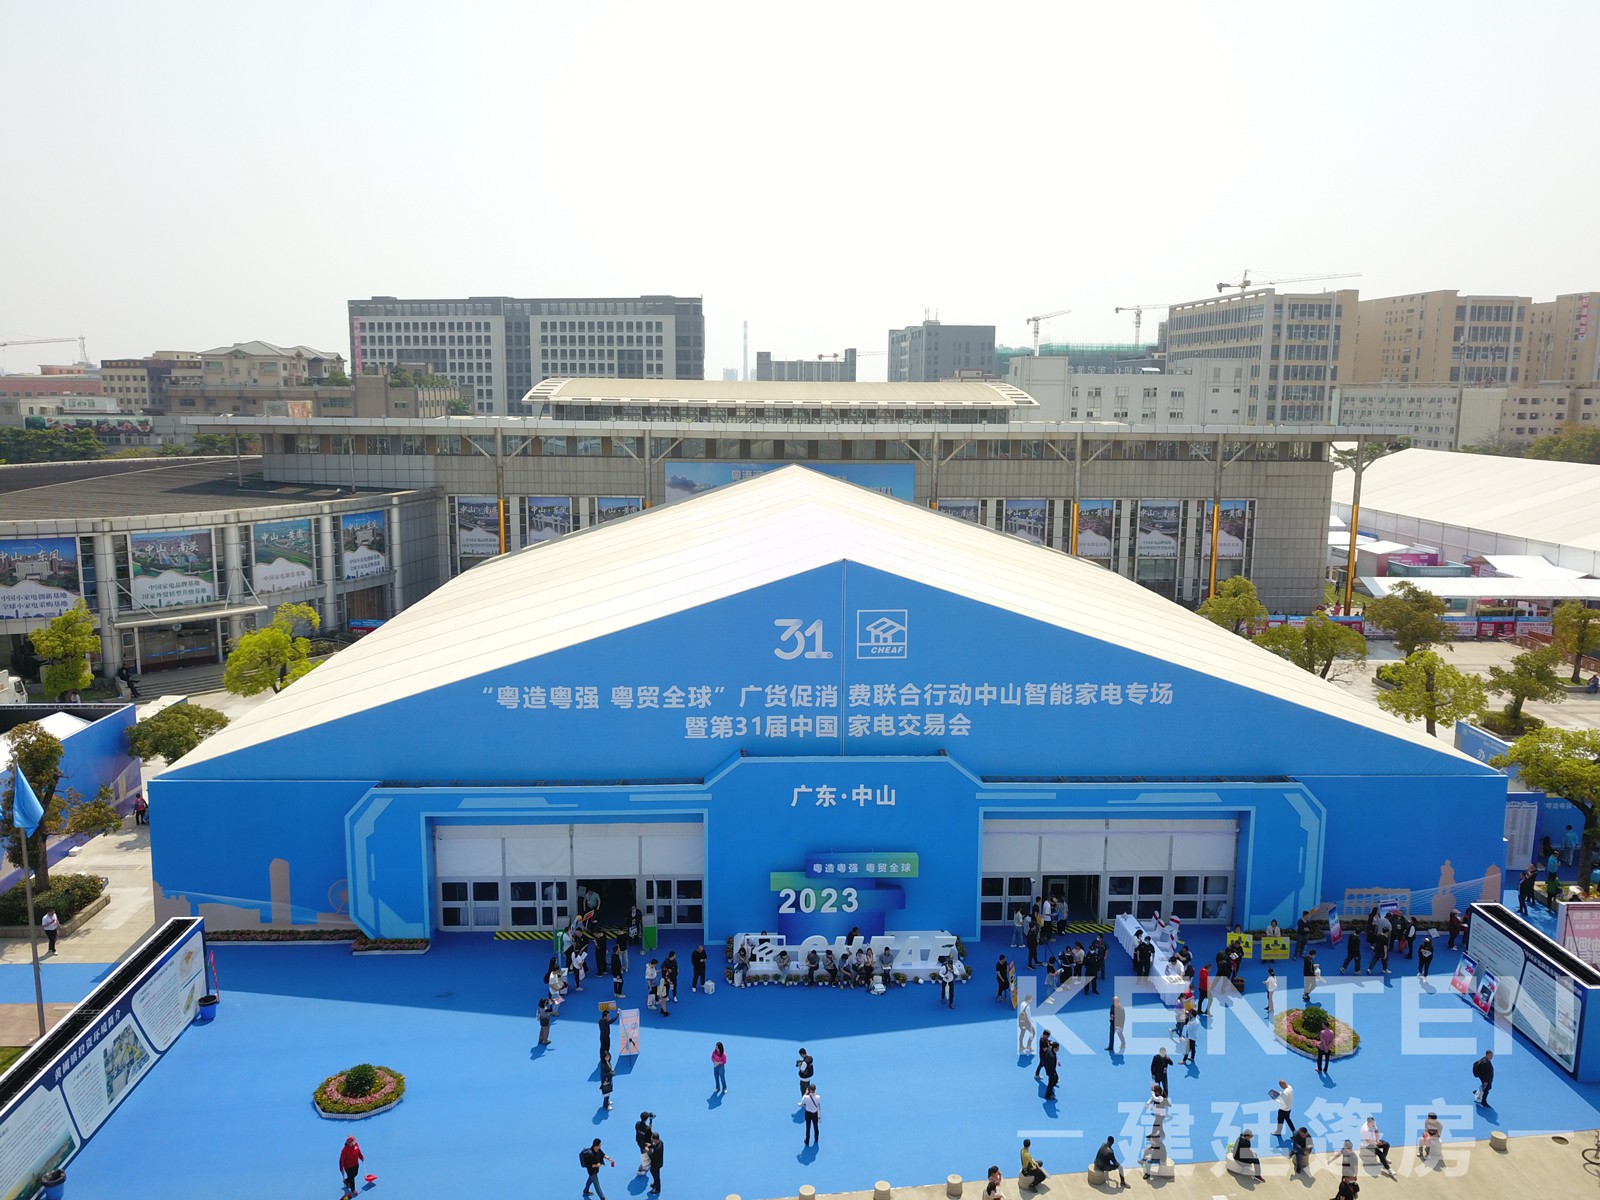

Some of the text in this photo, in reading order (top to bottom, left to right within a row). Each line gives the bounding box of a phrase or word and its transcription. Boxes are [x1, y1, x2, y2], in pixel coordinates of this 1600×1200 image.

[773, 618, 834, 660] 31
[870, 646, 904, 654] CHEAF
[790, 785, 897, 808] 广东·中山
[812, 862, 912, 874] 粤造粤强 粤贸全球
[778, 888, 859, 914] 2023
